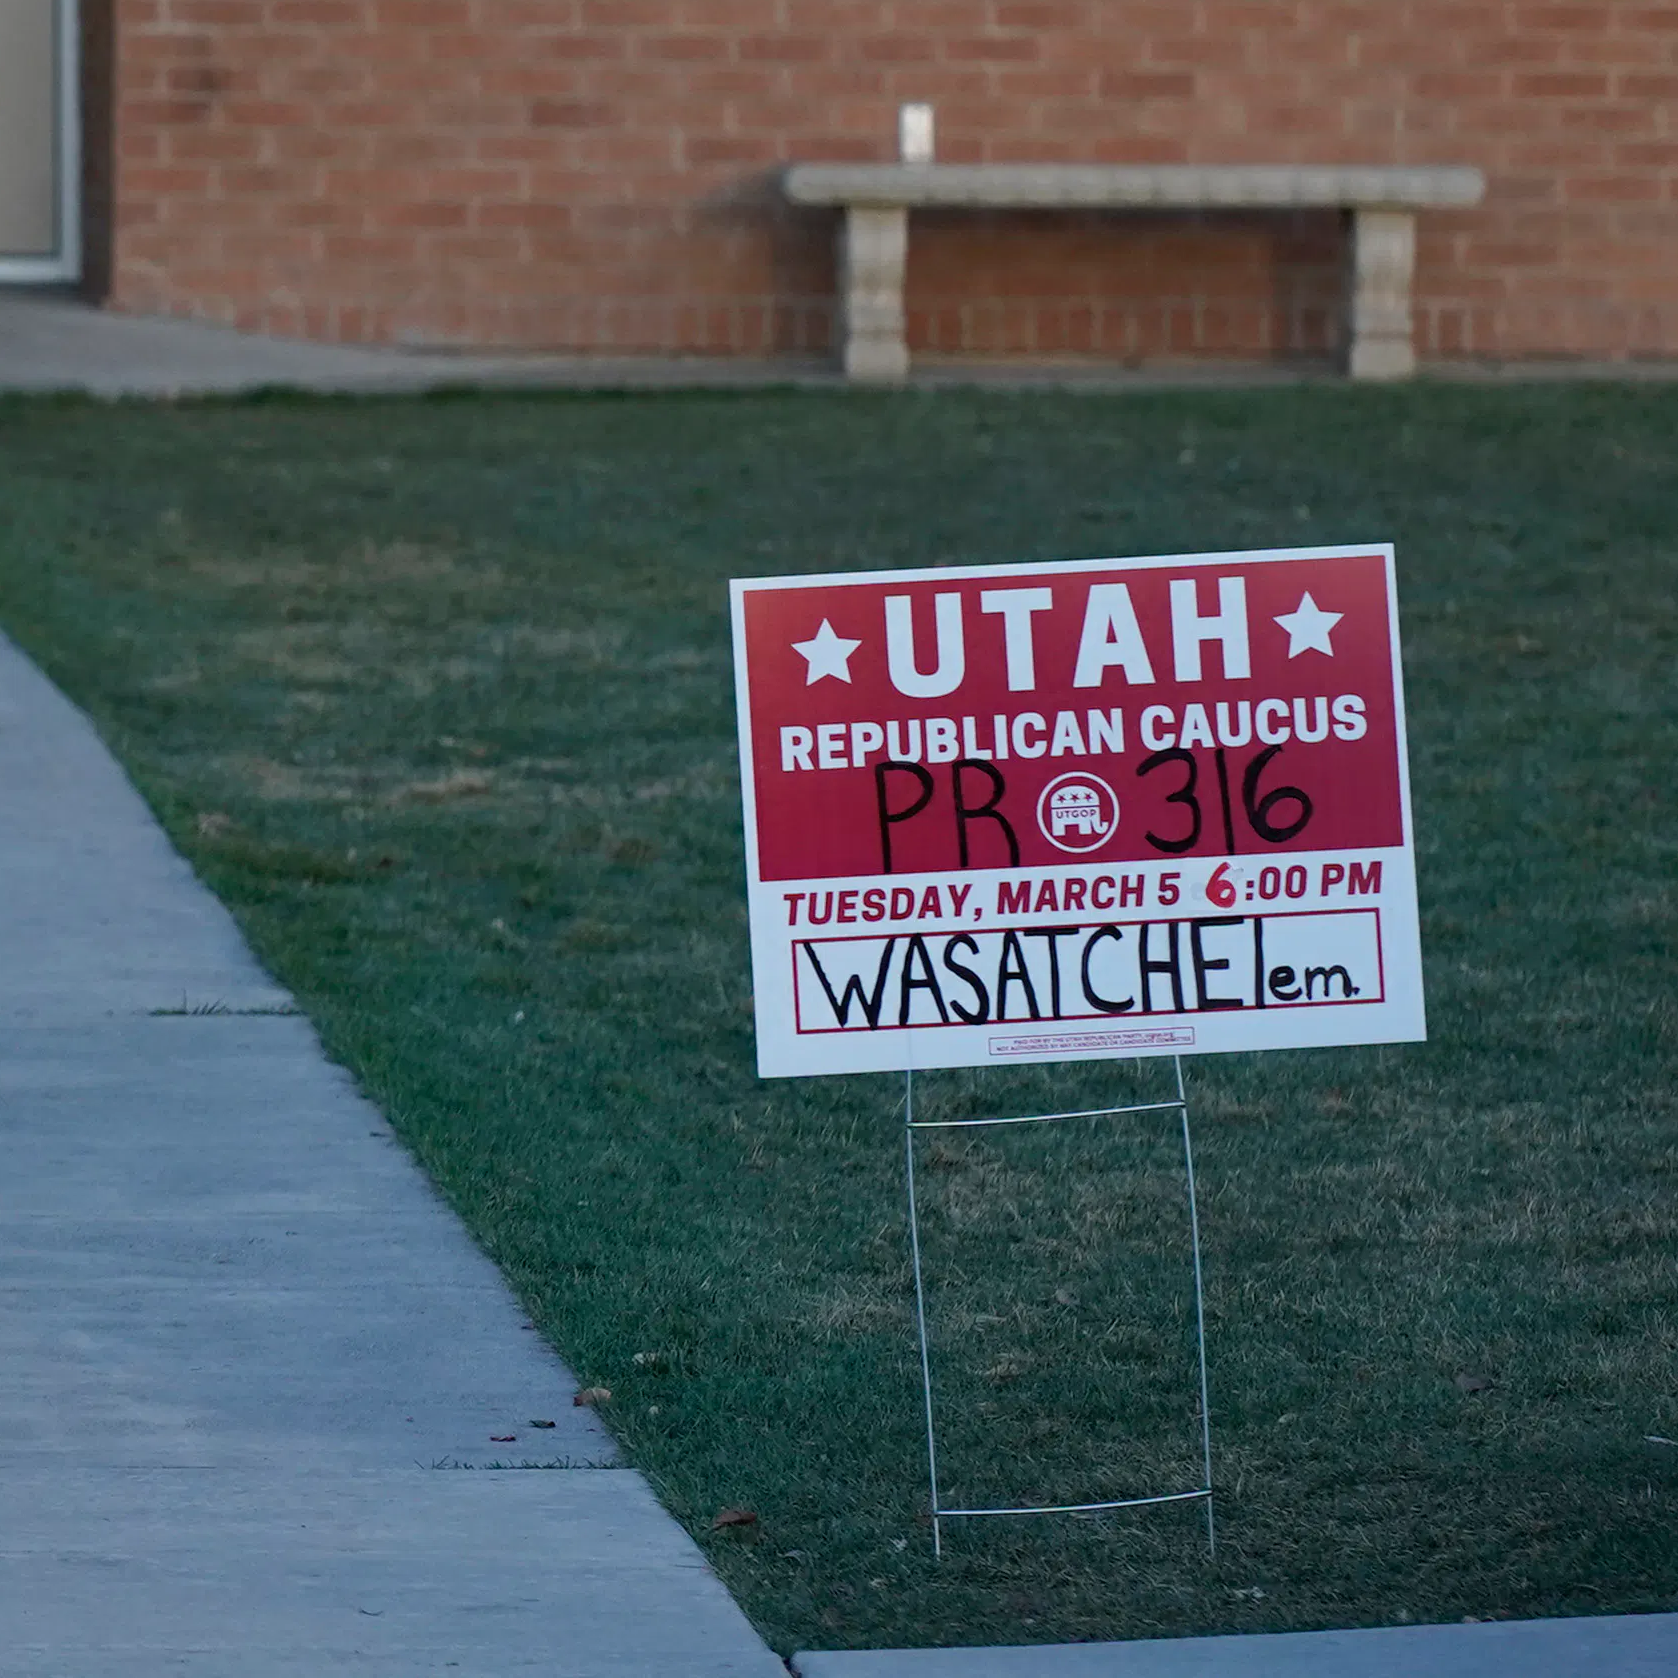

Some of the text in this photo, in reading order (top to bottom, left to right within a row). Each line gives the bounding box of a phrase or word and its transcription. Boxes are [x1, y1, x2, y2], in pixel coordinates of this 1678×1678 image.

[883, 575, 1252, 698] UTAH
[779, 694, 1367, 771] REPUBLICAN CAUCUS
[874, 746, 1313, 874] PR 316
[1055, 809, 1097, 819] UTGOP
[783, 861, 1383, 926] TUESDAY, MARCH 5 6:00 PM
